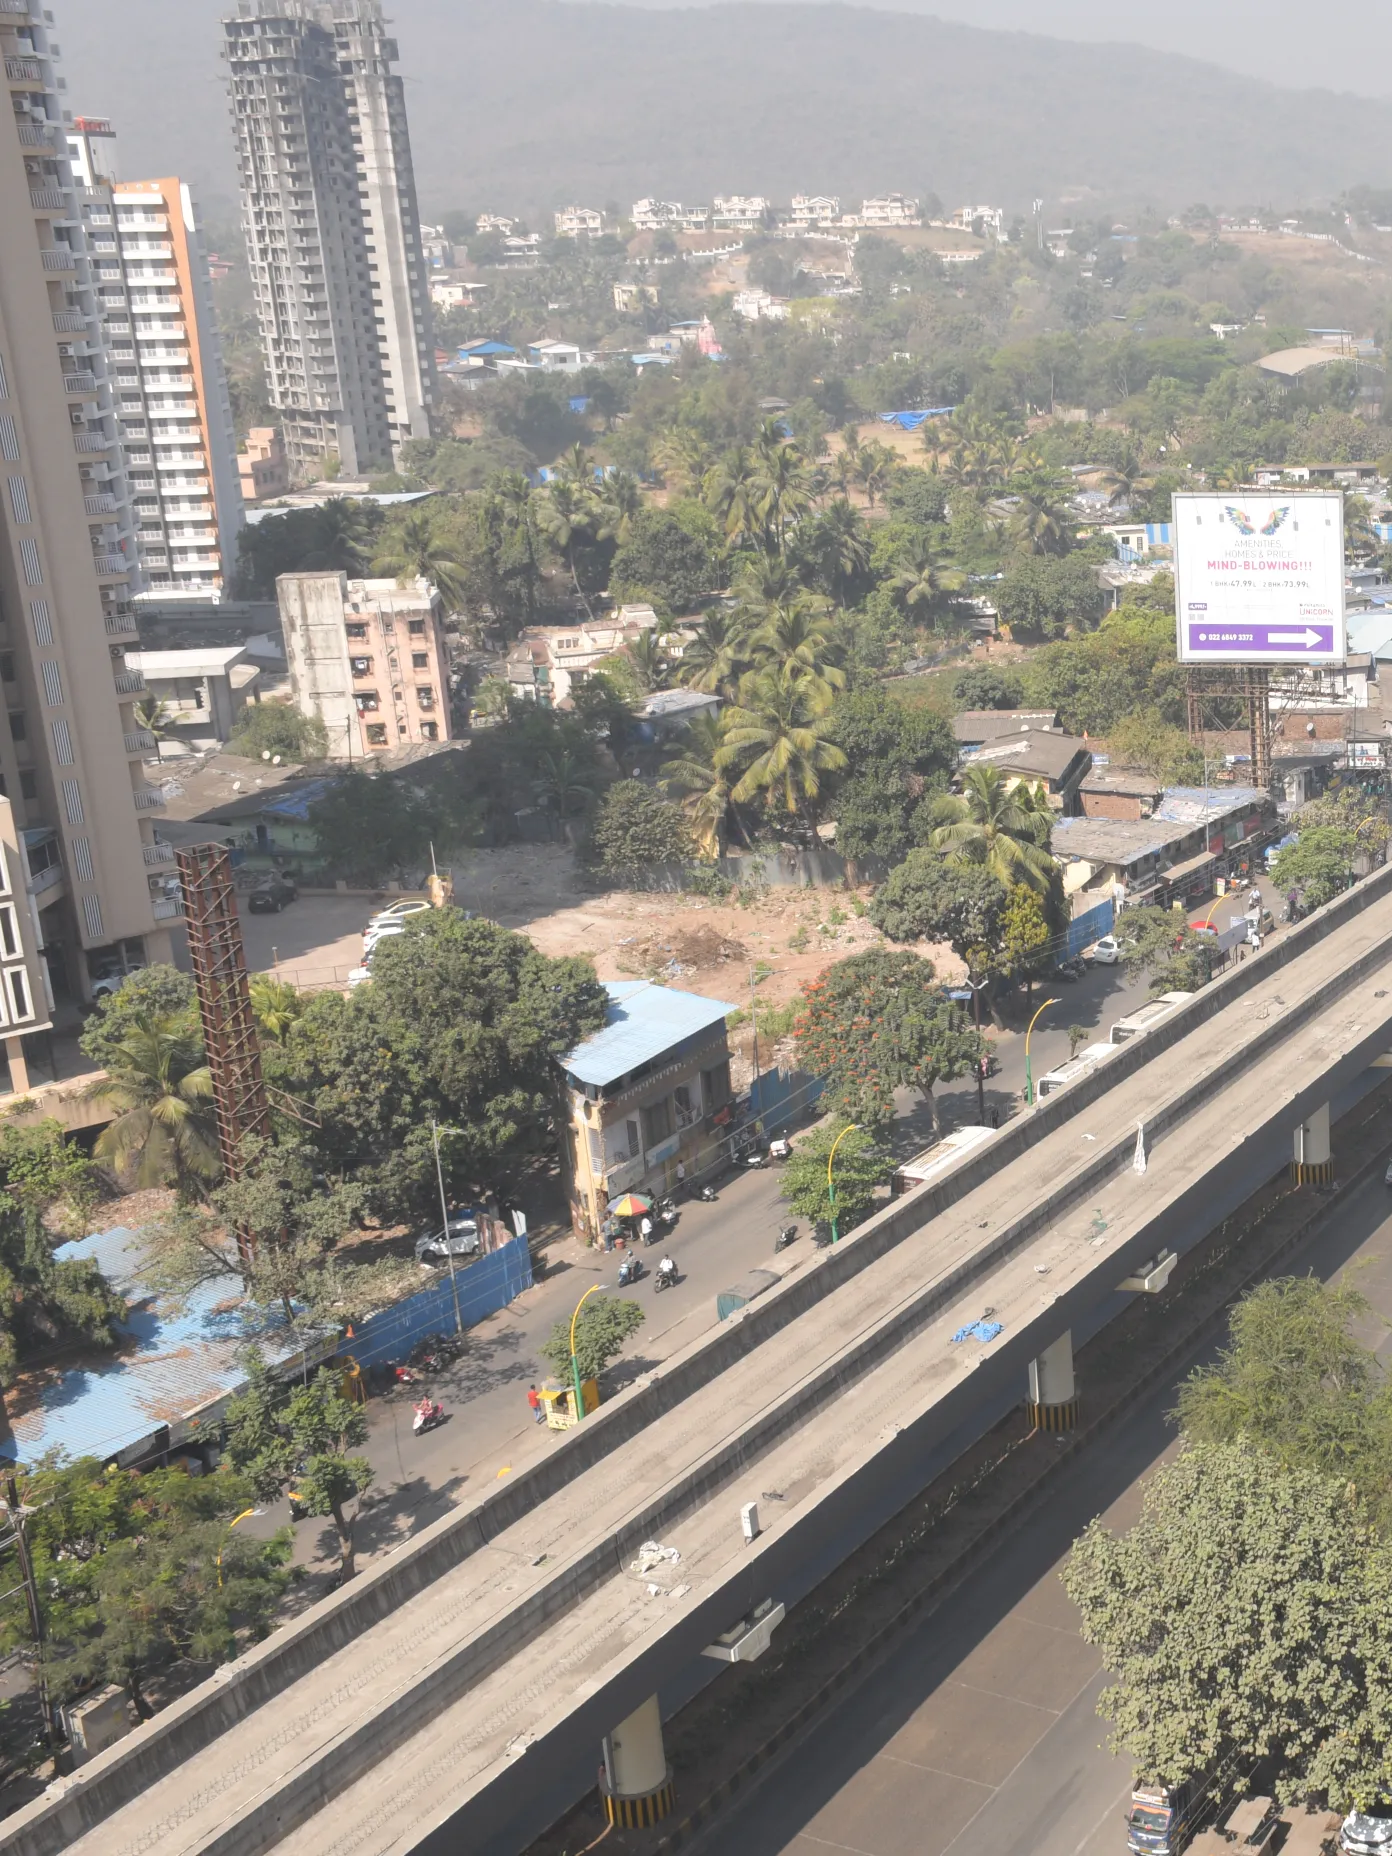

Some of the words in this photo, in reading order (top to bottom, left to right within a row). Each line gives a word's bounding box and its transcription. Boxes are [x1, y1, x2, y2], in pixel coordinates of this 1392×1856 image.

[1234, 539, 1284, 549] AMENITIES,
[1224, 549, 1257, 559] HOMES
[1258, 550, 1264, 559] &
[1266, 550, 1294, 559] PRICE
[1207, 560, 1312, 571] MIND-BLOWING!!!
[1208, 633, 1220, 641] 022
[1221, 633, 1237, 641] 6849
[1238, 633, 1254, 641] 3372
